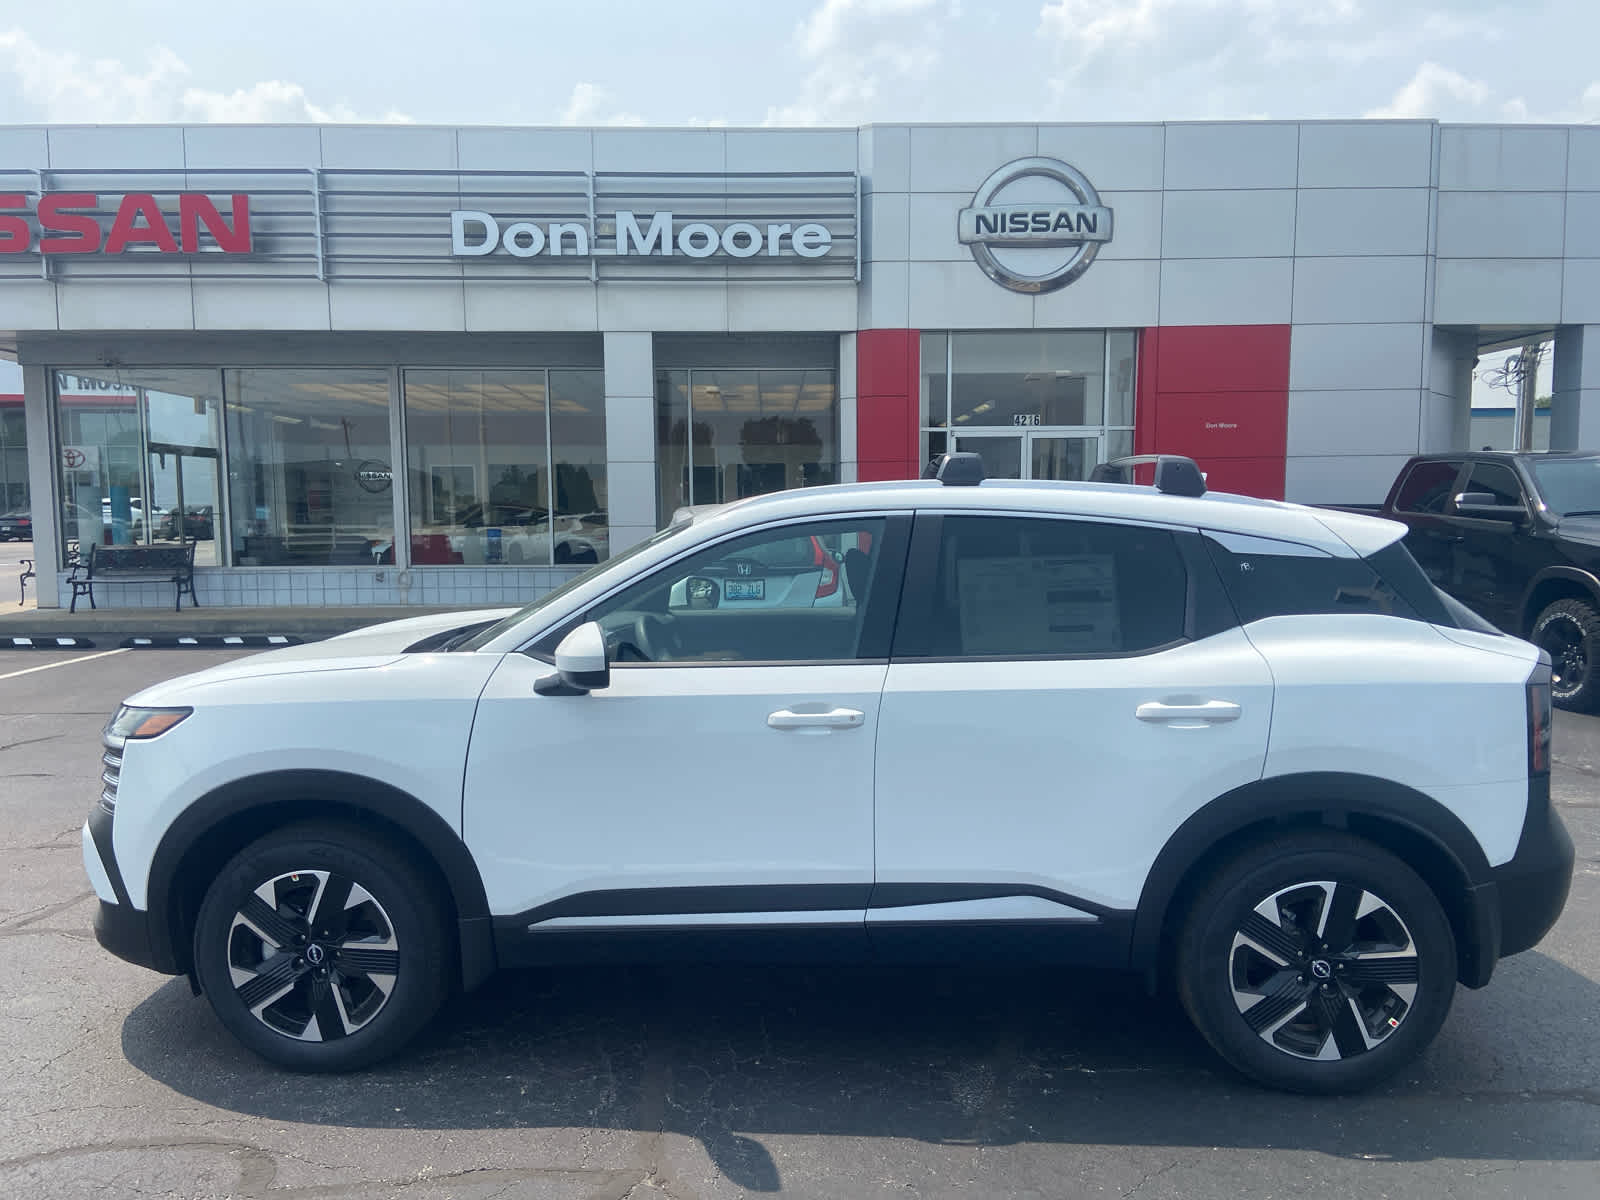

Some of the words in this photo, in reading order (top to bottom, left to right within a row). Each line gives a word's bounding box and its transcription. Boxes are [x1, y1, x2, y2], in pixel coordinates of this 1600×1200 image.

[451, 210, 589, 257] Don
[616, 210, 833, 258] Moore
[975, 211, 1098, 235] NISSAN
